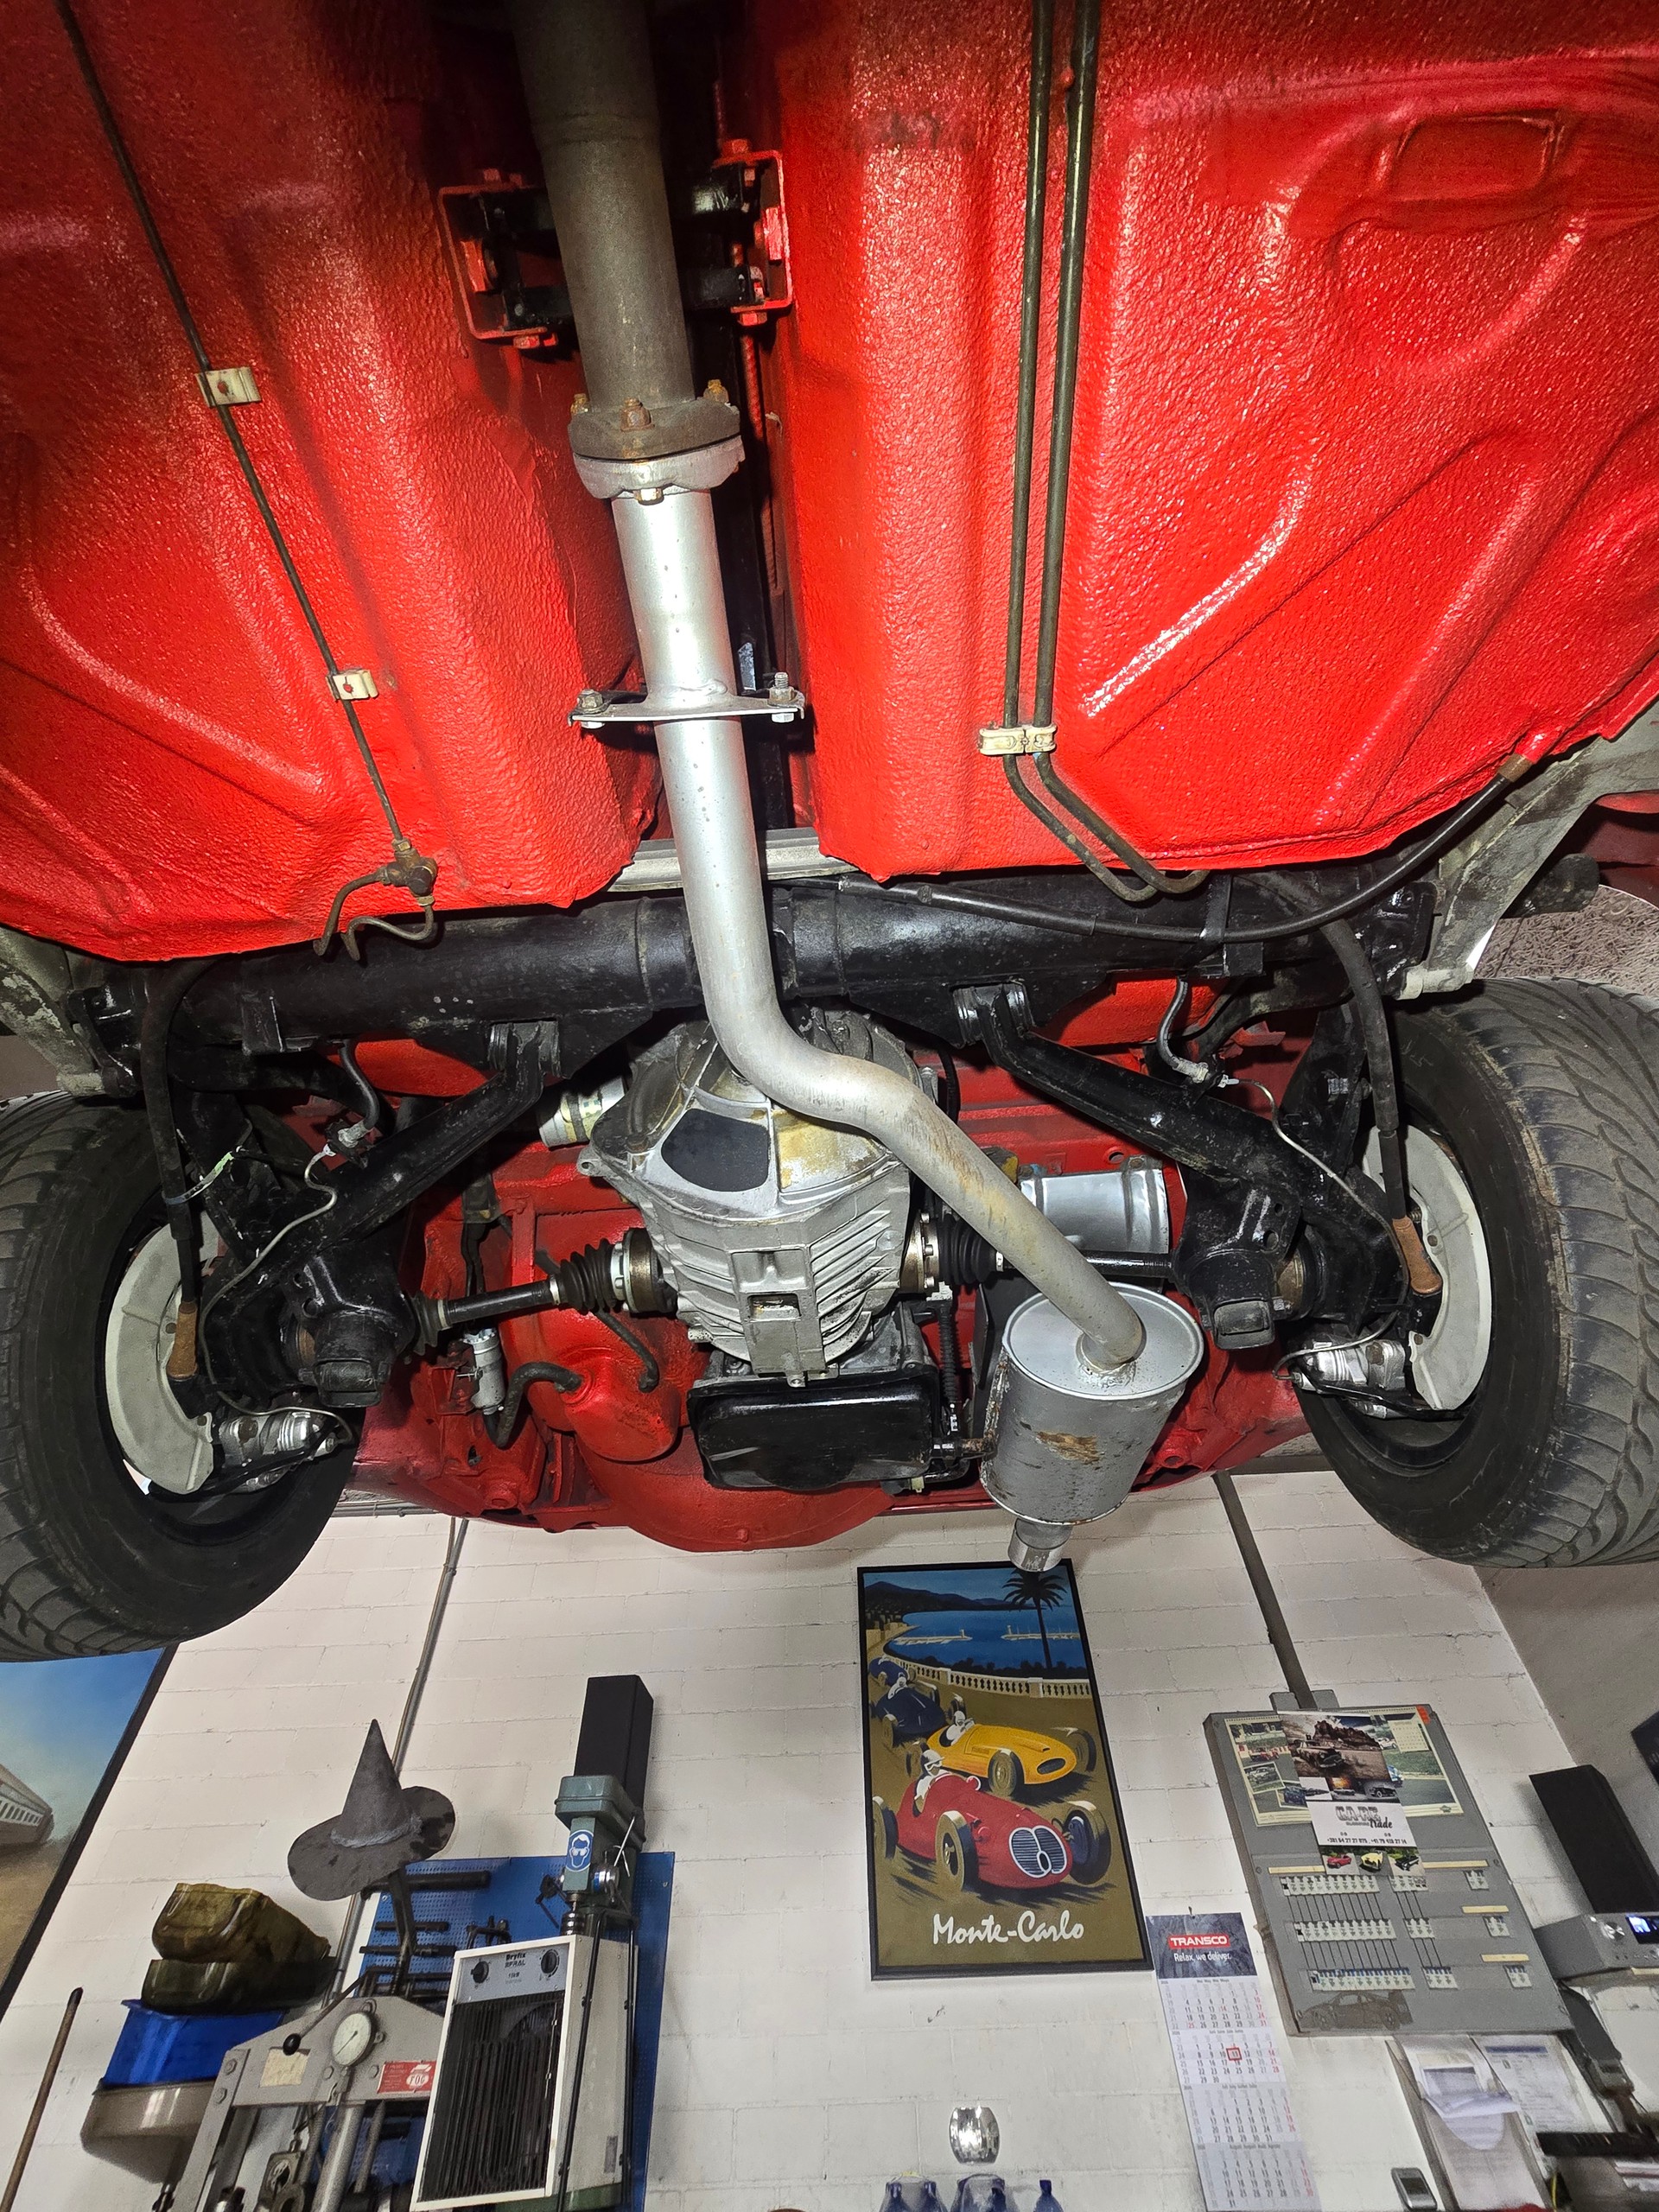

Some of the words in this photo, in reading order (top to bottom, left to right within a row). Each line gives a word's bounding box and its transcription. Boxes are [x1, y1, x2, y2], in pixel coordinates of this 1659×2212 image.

[933, 1910, 1084, 1944] Monte-Carlo
[1171, 1936, 1227, 1946] TRANSCO
[1174, 1953, 1195, 1962] Relax,
[1207, 1951, 1231, 1962] deliver.
